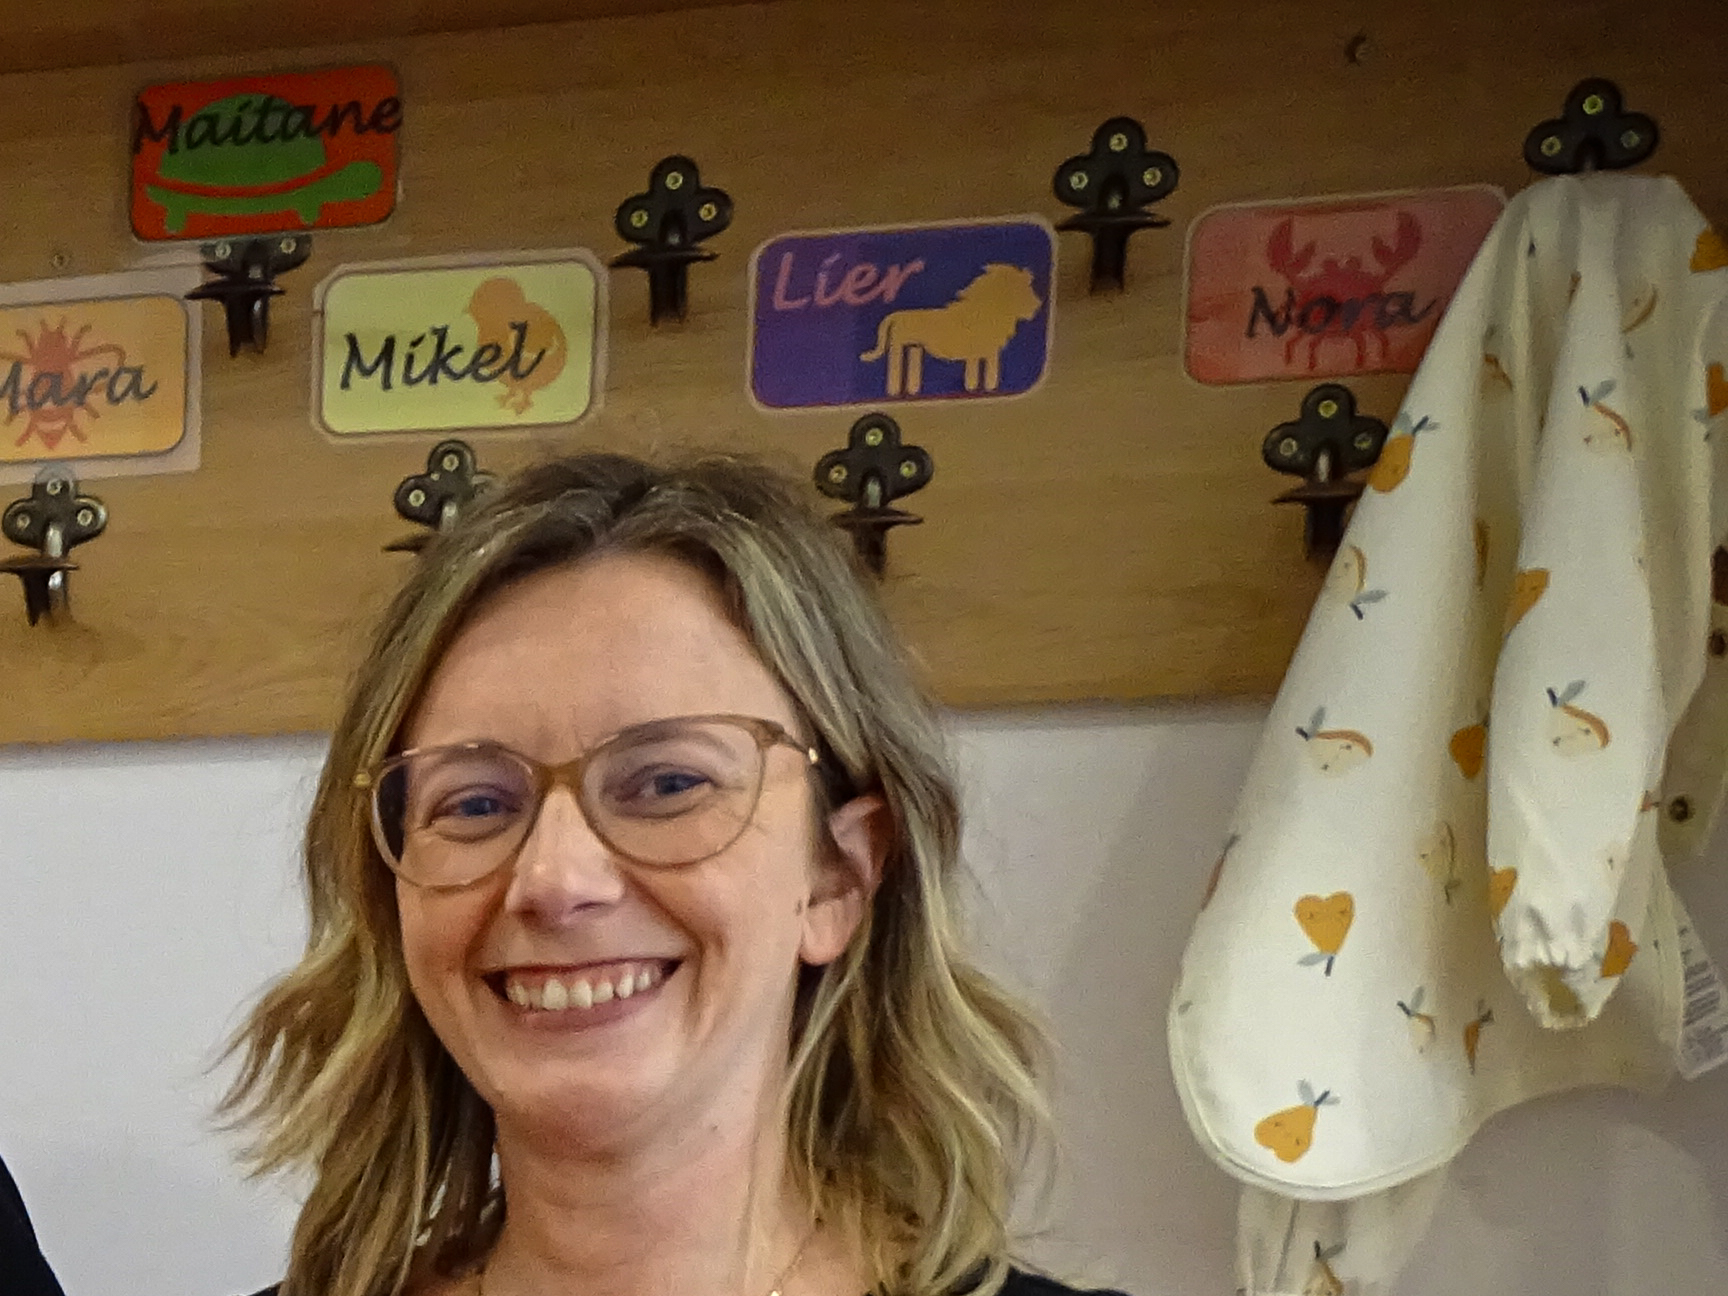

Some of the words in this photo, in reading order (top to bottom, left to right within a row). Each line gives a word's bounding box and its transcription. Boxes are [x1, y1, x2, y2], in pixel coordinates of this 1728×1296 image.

[133, 95, 403, 155] Maitane
[773, 251, 925, 311] Lier
[1246, 286, 1438, 338] Nora
[340, 320, 546, 391] Mikel
